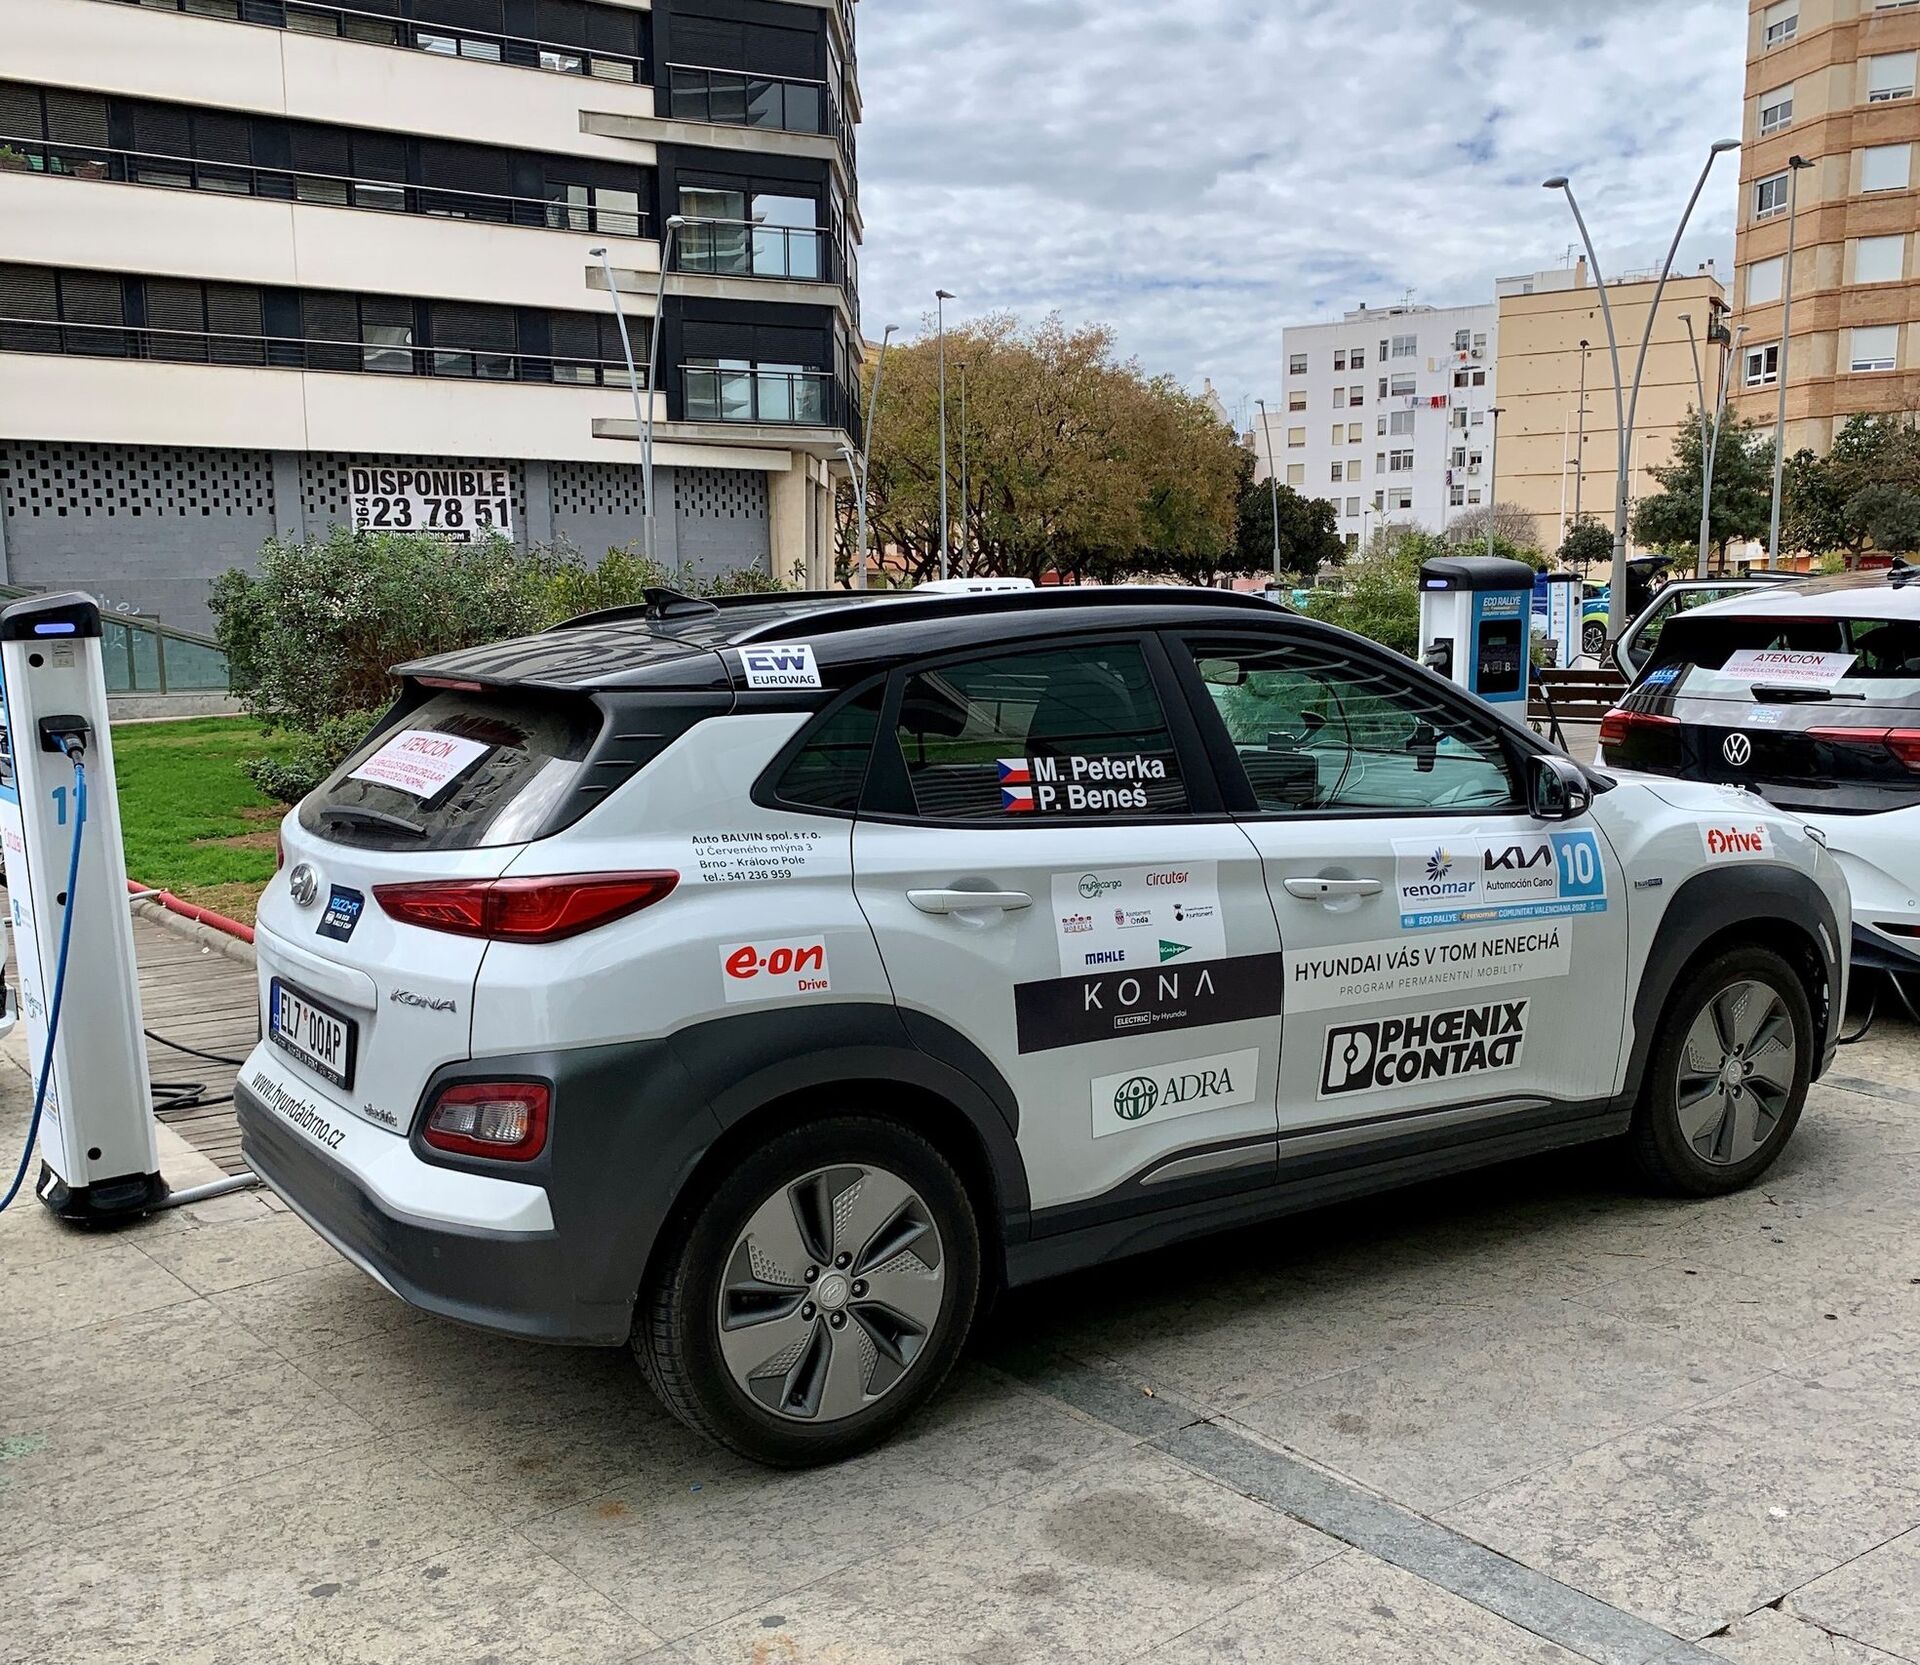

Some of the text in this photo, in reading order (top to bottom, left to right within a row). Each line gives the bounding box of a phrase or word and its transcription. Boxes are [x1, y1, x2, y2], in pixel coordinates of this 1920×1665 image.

[352, 469, 506, 496] DISPONIBLE
[355, 497, 370, 527] 964
[372, 497, 509, 527] 23 78 51
[1483, 597, 1521, 607] ECO RALLYE
[1753, 653, 1825, 664] ATENCIÓN
[752, 675, 815, 685] EUROWAG
[1033, 755, 1166, 782] M. Peterka
[1038, 782, 1148, 810] P. Beneš
[692, 835, 719, 845] Auto
[721, 832, 763, 843] BALVIN
[765, 831, 792, 843] spol.
[695, 843, 813, 856] U Červeného mlýna 3
[699, 860, 727, 869] Brno
[736, 856, 779, 867] Královo
[781, 856, 805, 865] Pole
[1562, 842, 1594, 885] 10
[703, 869, 792, 882] tel.: 541 236 959
[1146, 871, 1189, 886] Circutor
[1486, 877, 1553, 891] Automoción Cano
[1402, 881, 1475, 897] renomar
[1419, 916, 1432, 925] ECO
[1433, 914, 1457, 924] RALLYE
[1572, 903, 1587, 911] 2022
[1085, 950, 1125, 965] MAHLE
[1295, 927, 1560, 982] HYUNDAI VÁS V TOM NENECHÁ
[798, 978, 828, 991] Drive
[1084, 969, 1215, 1011] KONA
[1340, 963, 1524, 996] PROGRAM PERMANENTNÍ MOBILITY
[390, 988, 457, 1013] KONA
[1116, 1010, 1187, 1025] ELECTRIC by Hyundai
[1375, 1034, 1522, 1086] CONTACT
[1160, 1068, 1235, 1106] ADRA
[251, 1071, 347, 1150] www.hyundaibrno.cz
